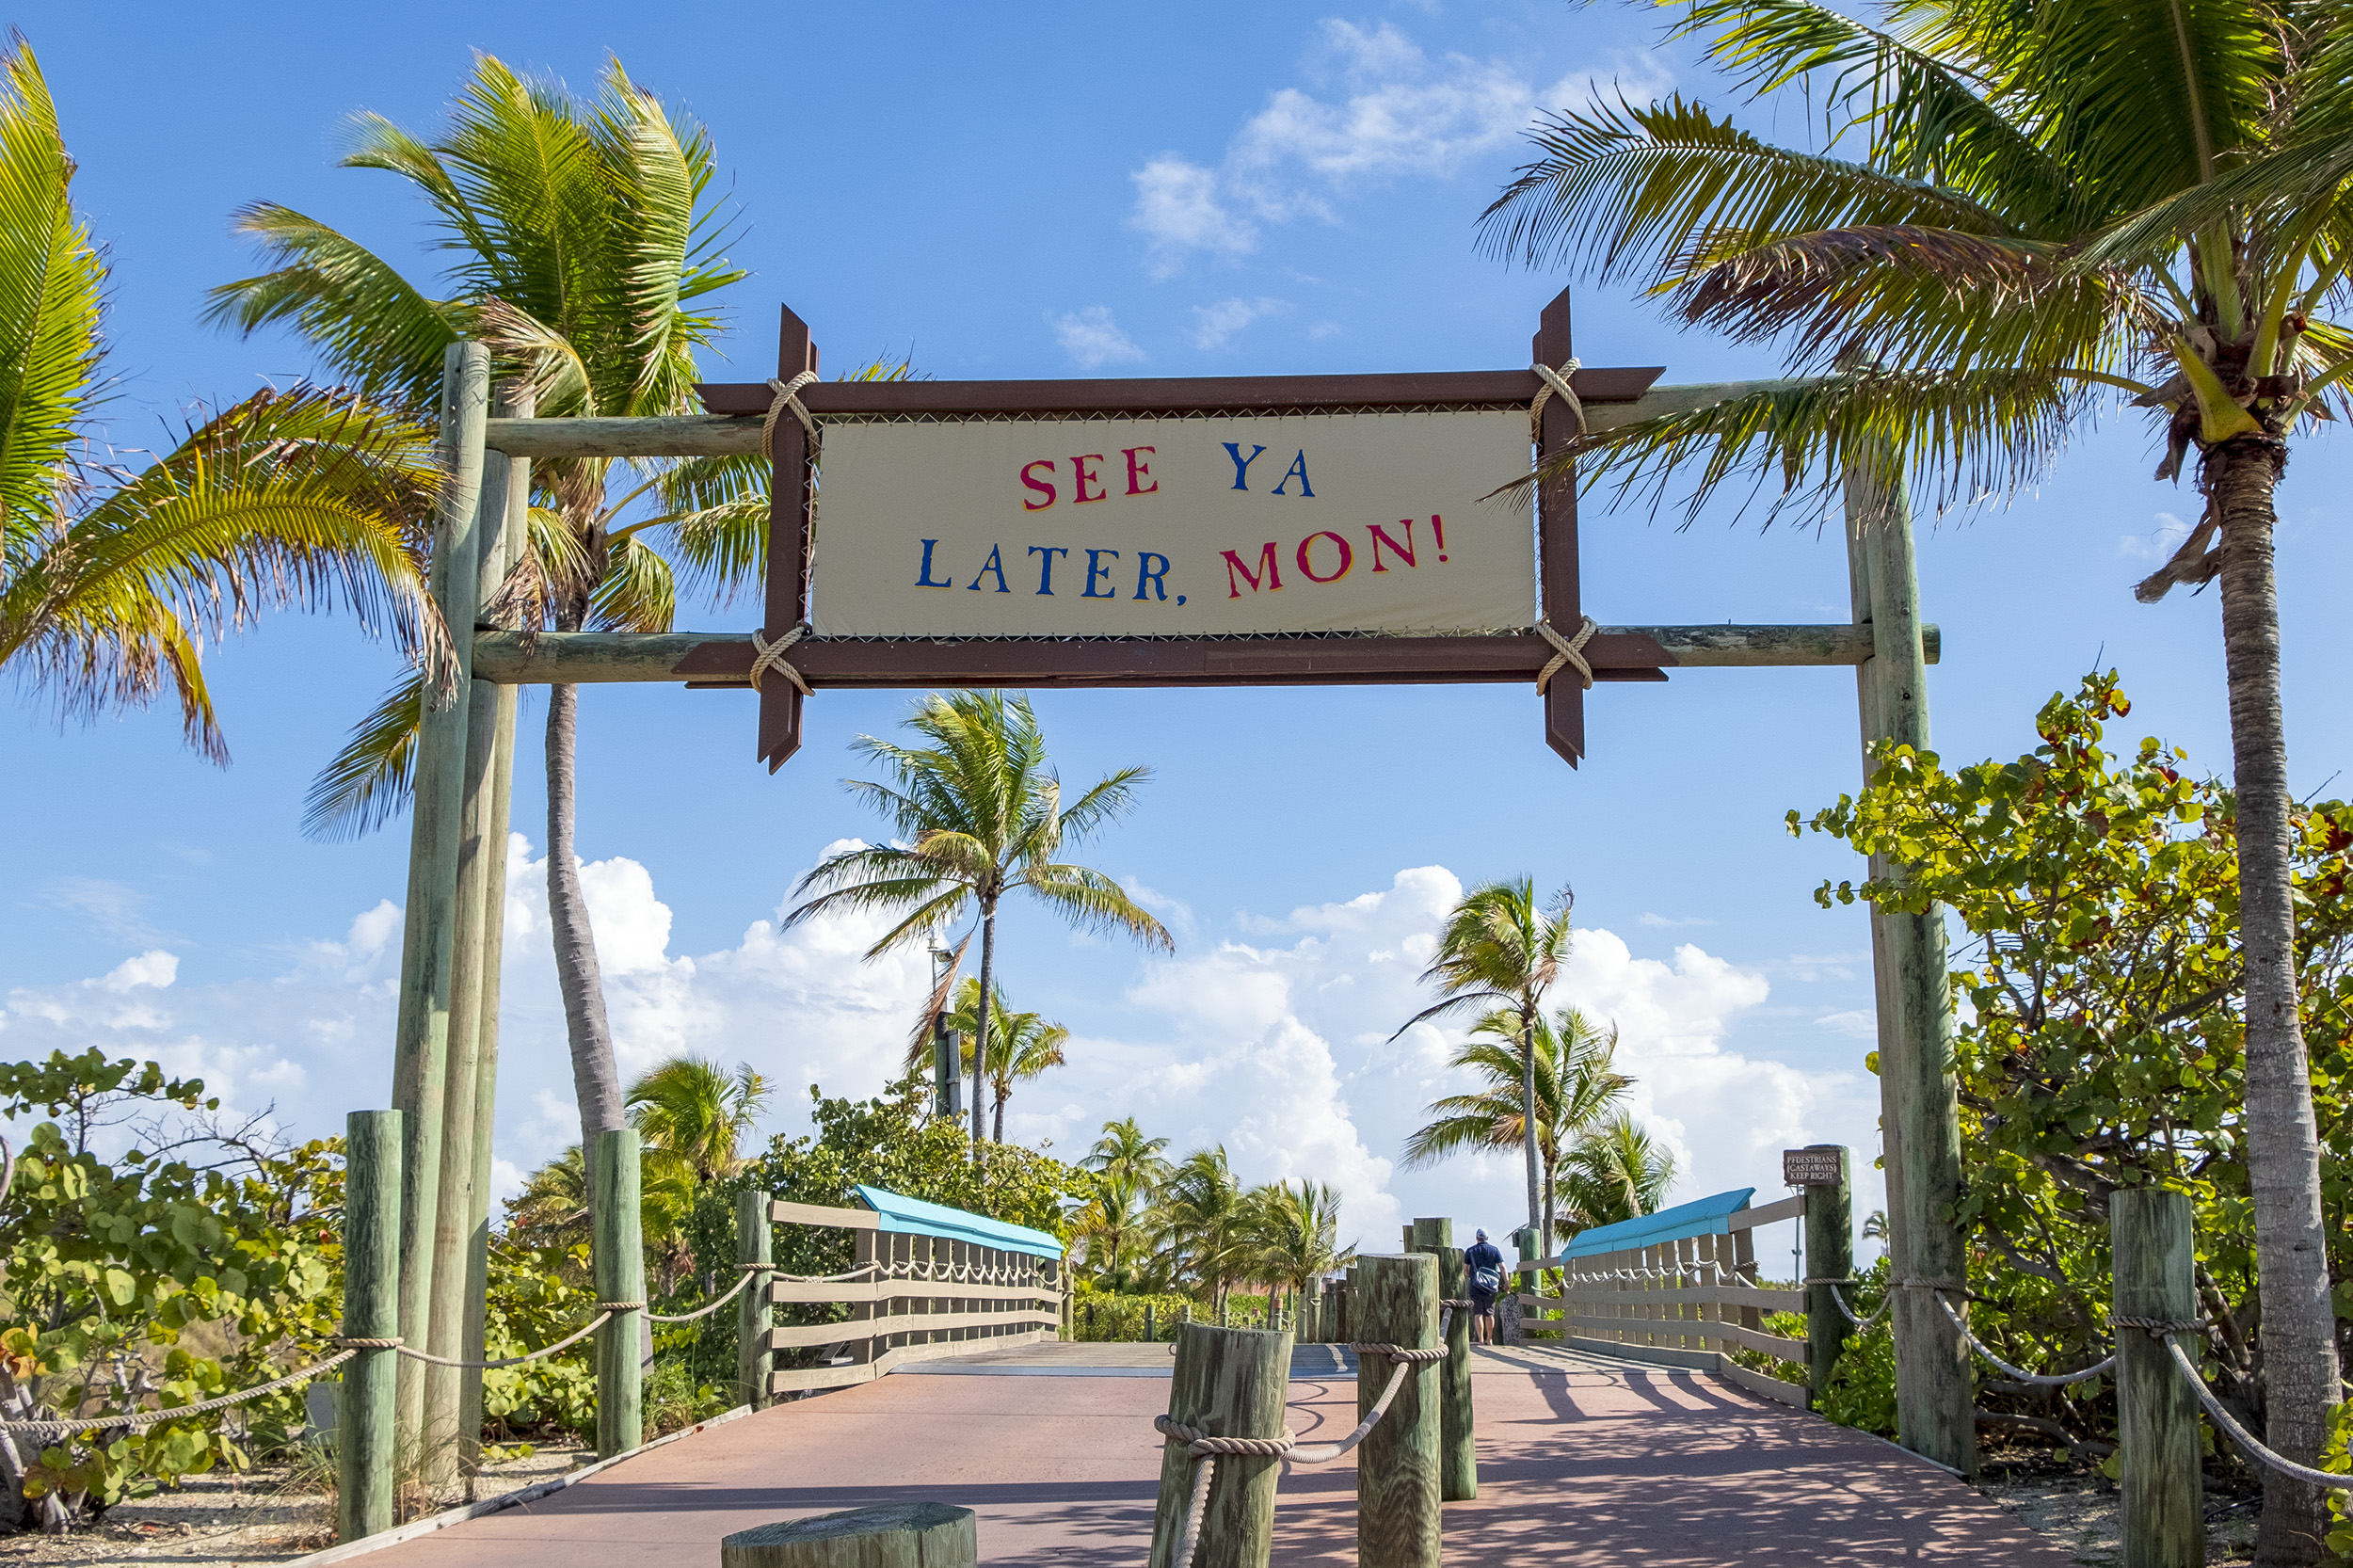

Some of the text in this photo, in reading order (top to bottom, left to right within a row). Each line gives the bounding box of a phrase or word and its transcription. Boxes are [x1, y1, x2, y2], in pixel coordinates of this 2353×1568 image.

[1019, 441, 1316, 512] SEE YA
[914, 514, 1449, 606] LATER, MON!
[1786, 1156, 1837, 1164] PEDESTRIANS
[1786, 1164, 1837, 1173] (CASTAWAYS)
[1790, 1172, 1833, 1180] KEEP RIGHT
